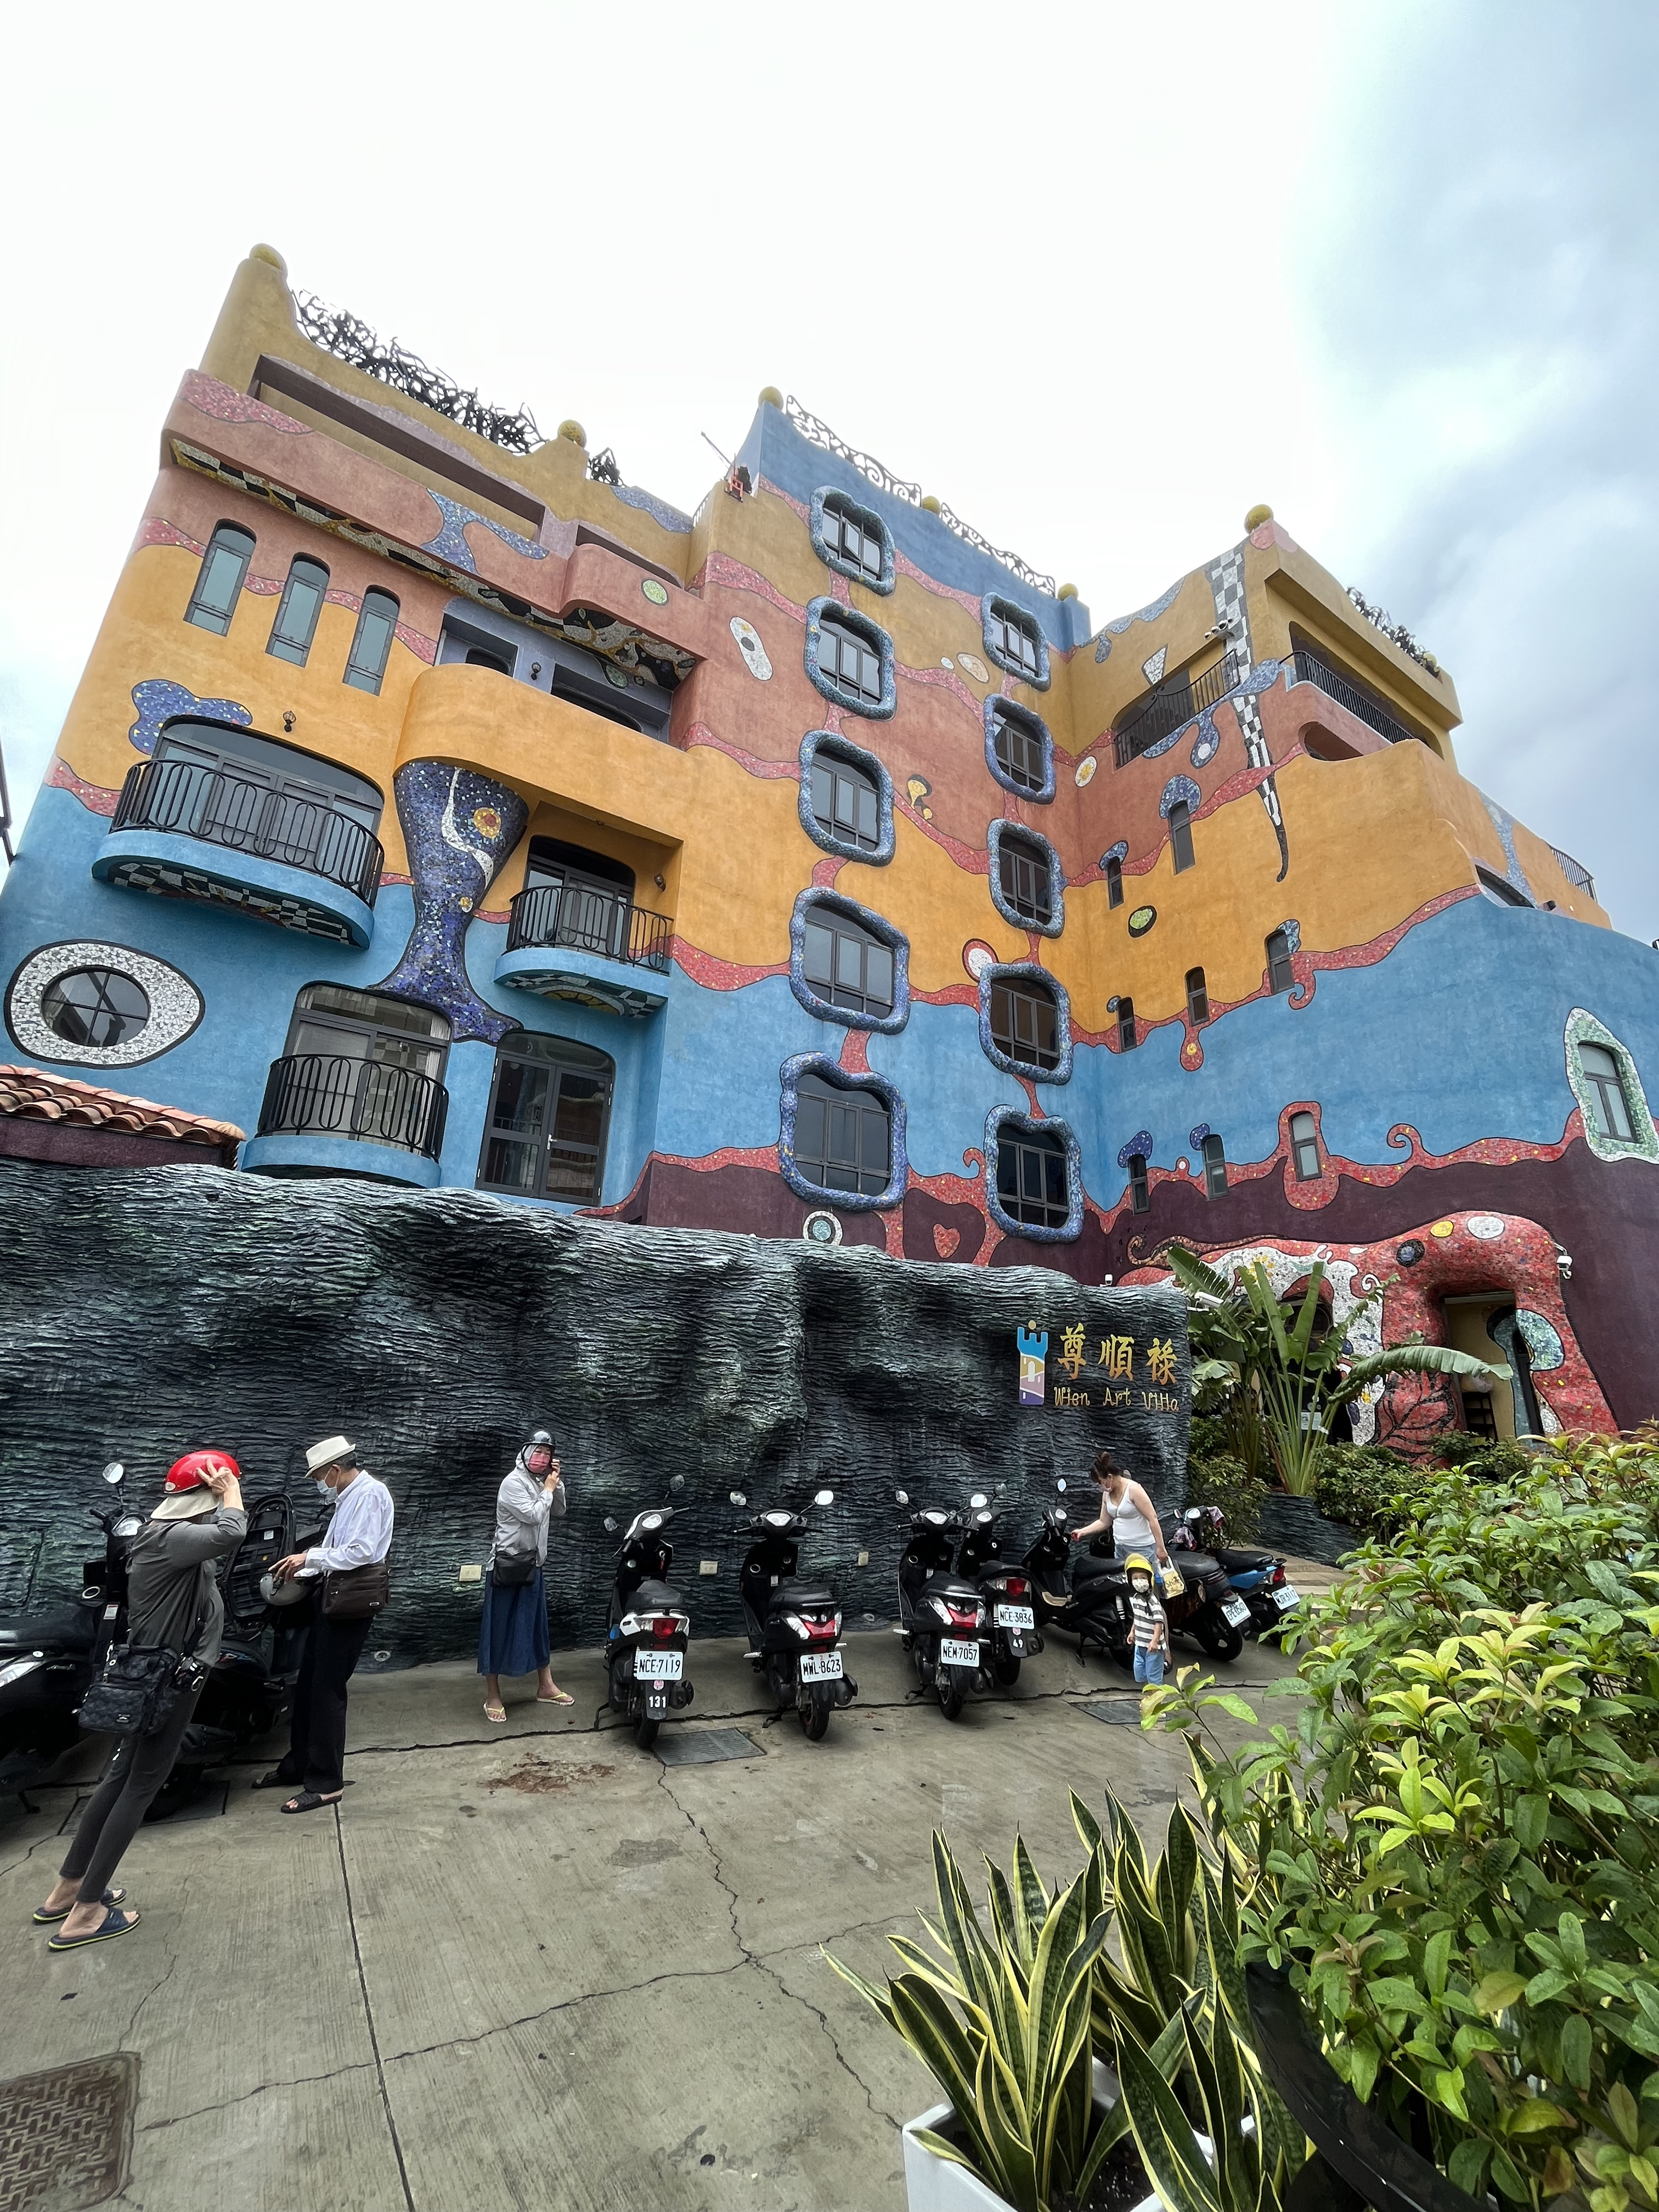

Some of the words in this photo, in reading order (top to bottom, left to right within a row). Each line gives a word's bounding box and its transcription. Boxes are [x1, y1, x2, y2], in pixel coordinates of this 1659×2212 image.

[1053, 1386, 1091, 1407] Wien
[1102, 1387, 1132, 1407] Art
[1000, 1610, 1032, 1624] NCE-3836
[639, 1659, 681, 1673] NCE-7119
[649, 1695, 667, 1708] 131
